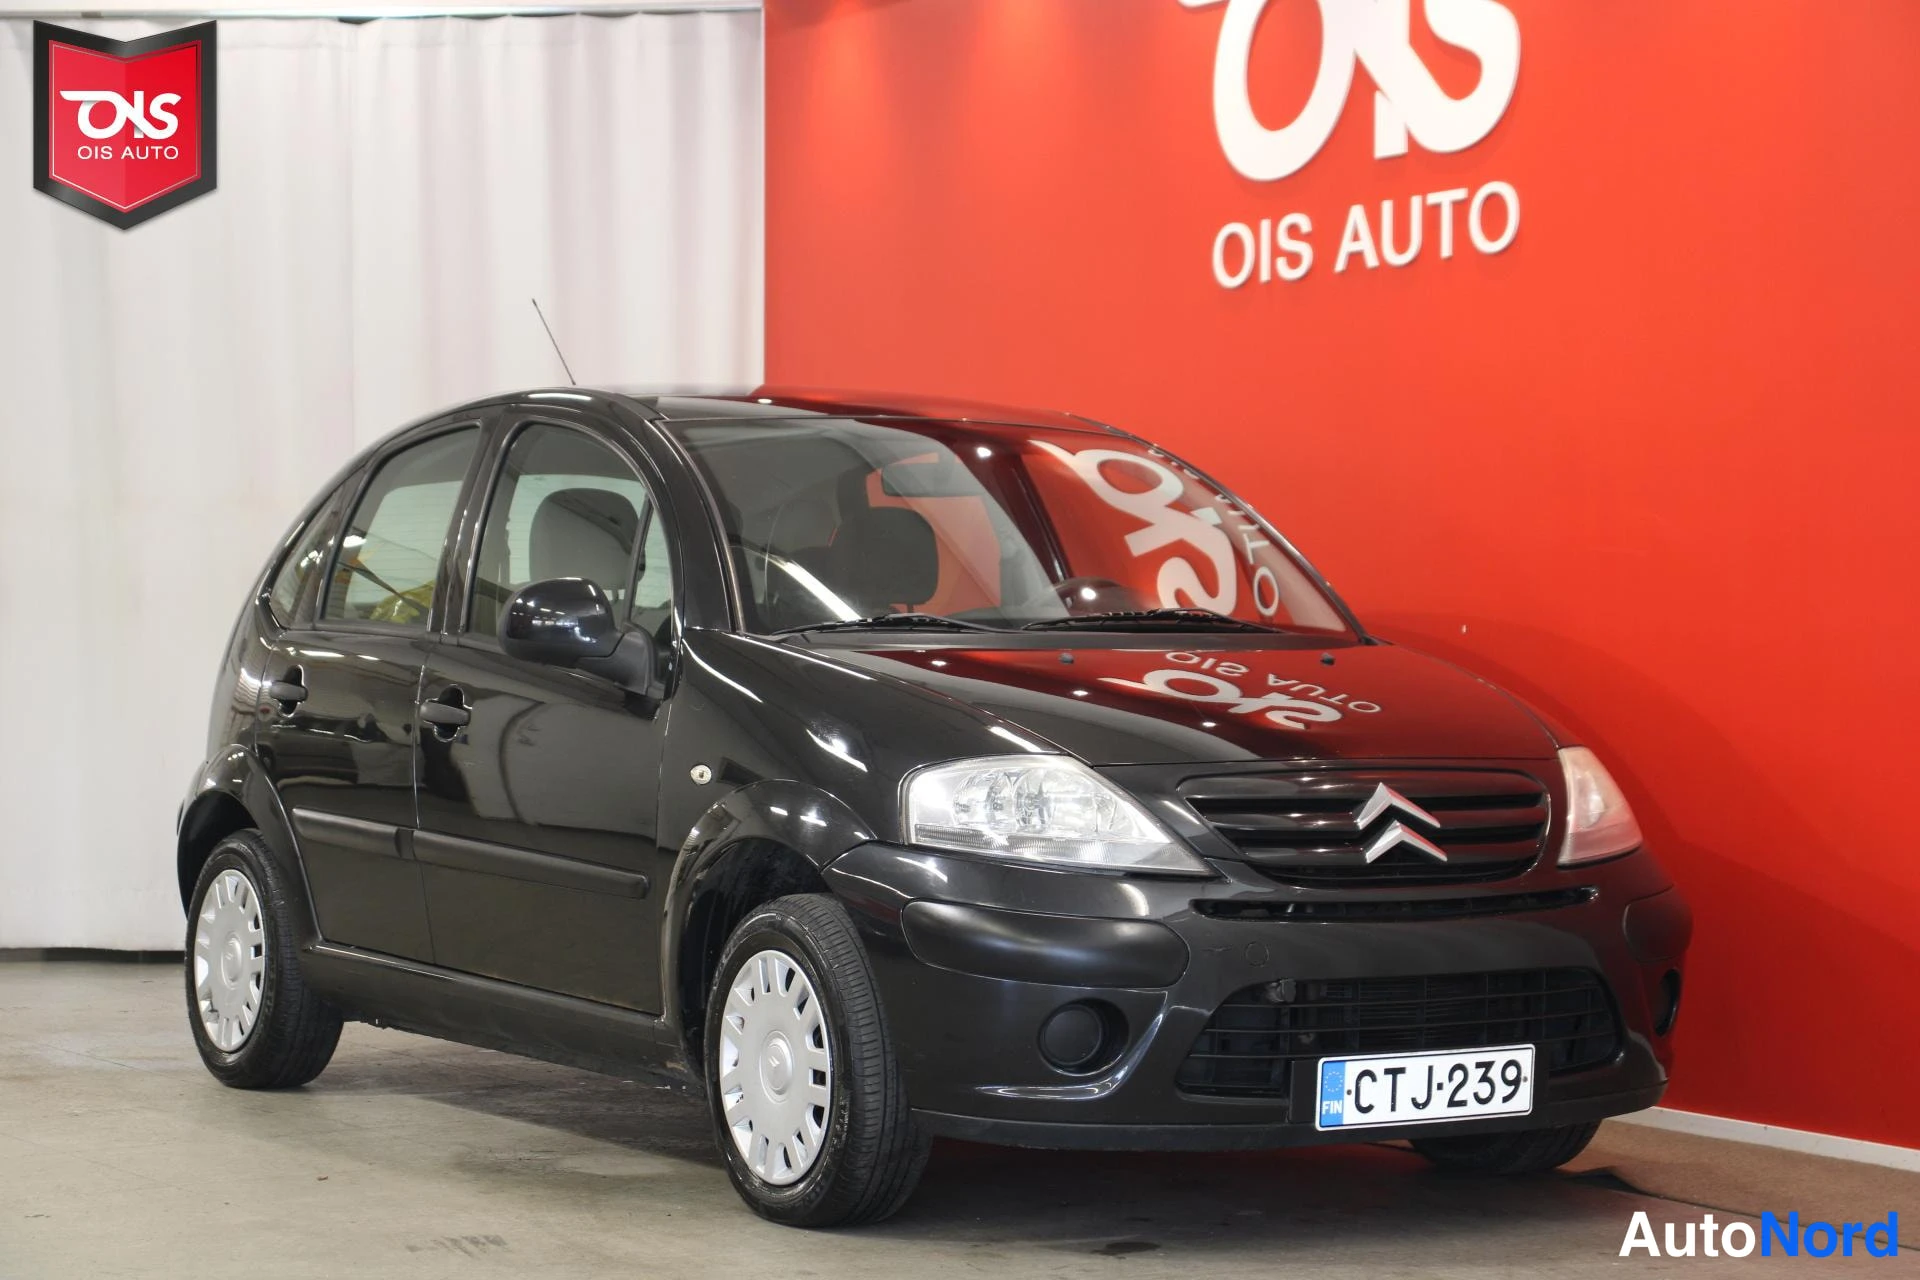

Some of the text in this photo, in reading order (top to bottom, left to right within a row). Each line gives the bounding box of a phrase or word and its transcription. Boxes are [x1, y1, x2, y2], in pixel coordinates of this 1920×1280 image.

[1212, 181, 1521, 289] OIS AUTO
[1321, 1059, 1522, 1115] FIN CTJ-239
